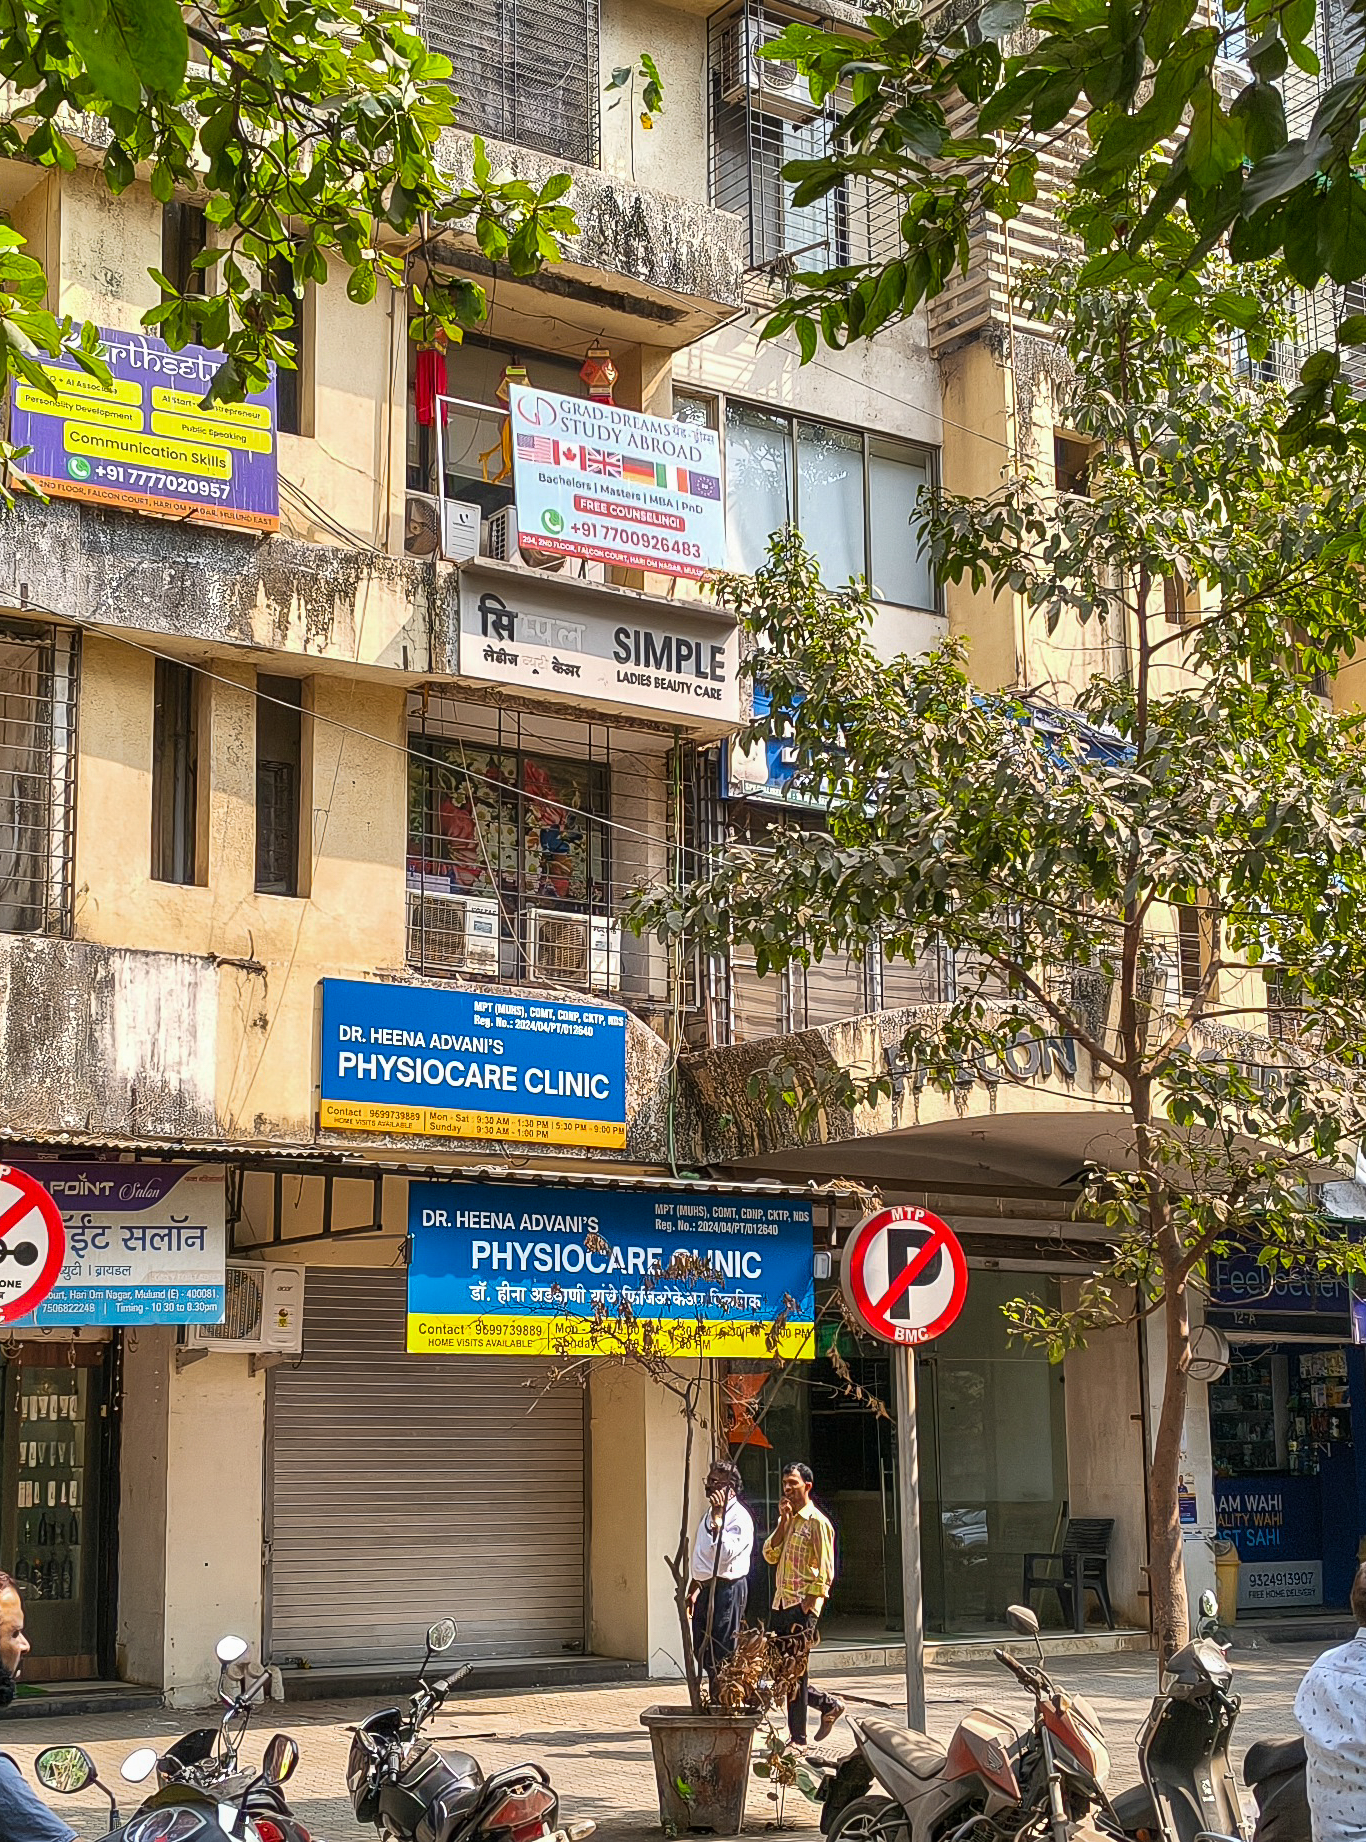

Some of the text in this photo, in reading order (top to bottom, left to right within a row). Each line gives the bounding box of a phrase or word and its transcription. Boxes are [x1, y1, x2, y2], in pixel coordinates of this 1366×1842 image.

[76, 402, 133, 421] Development
[560, 399, 671, 437] GRAD-DREAMS
[560, 417, 623, 444] STUDY
[627, 433, 703, 463] ABROAD
[69, 430, 227, 470] Communication Skills
[95, 463, 231, 501] +91 7777020957
[538, 472, 592, 492] Bachelors
[600, 483, 641, 502] Masters
[580, 499, 608, 515] FREE
[570, 522, 702, 560] +91 7700926483
[613, 626, 726, 684] SIMPLE
[616, 669, 723, 702] LADIES BEAUTY CARE
[474, 1001, 494, 1013] MPT
[474, 1014, 494, 1028] Reg.
[339, 1025, 504, 1055] DR. HEENA ADVANI'S
[338, 1051, 611, 1100] PHYSIOCARE CLINIC
[327, 1106, 362, 1117] Contact
[429, 1112, 510, 1126] Mon AM
[429, 1122, 510, 1136] Sunday AM
[50, 1174, 162, 1201] POINT Salon
[422, 1210, 599, 1233] DR. HEENA ADVANI'S
[655, 1204, 810, 1222] MPT (MUHS), COMT, CKTP, NDS
[891, 1207, 925, 1221] MTP
[120, 1215, 208, 1252] सलॉन
[655, 1219, 778, 1235] Reg. No.: 2024/04/PT/012640
[471, 1240, 663, 1275] PHYSIOCARE
[887, 1229, 943, 1320] P
[1216, 1260, 1267, 1295] Feel
[69, 1289, 179, 1302] Hari Om Nagar, Mulund (E)
[469, 1280, 491, 1301] डॉ.
[496, 1283, 527, 1303] हीना
[43, 1303, 218, 1314] 7506822248 Timing 8.30pm
[419, 1323, 542, 1336] Contact 9699739889
[895, 1327, 929, 1343] BMC
[428, 1338, 533, 1348] HOME VISITS AVAILABLE
[1245, 1494, 1283, 1512] WAHI
[1254, 1512, 1283, 1527] WAHI
[1247, 1529, 1281, 1546] SAHI
[1249, 1572, 1314, 1587] 9324913907
[1248, 1590, 1265, 1599] FREE
[1266, 1589, 1285, 1598] HOME
